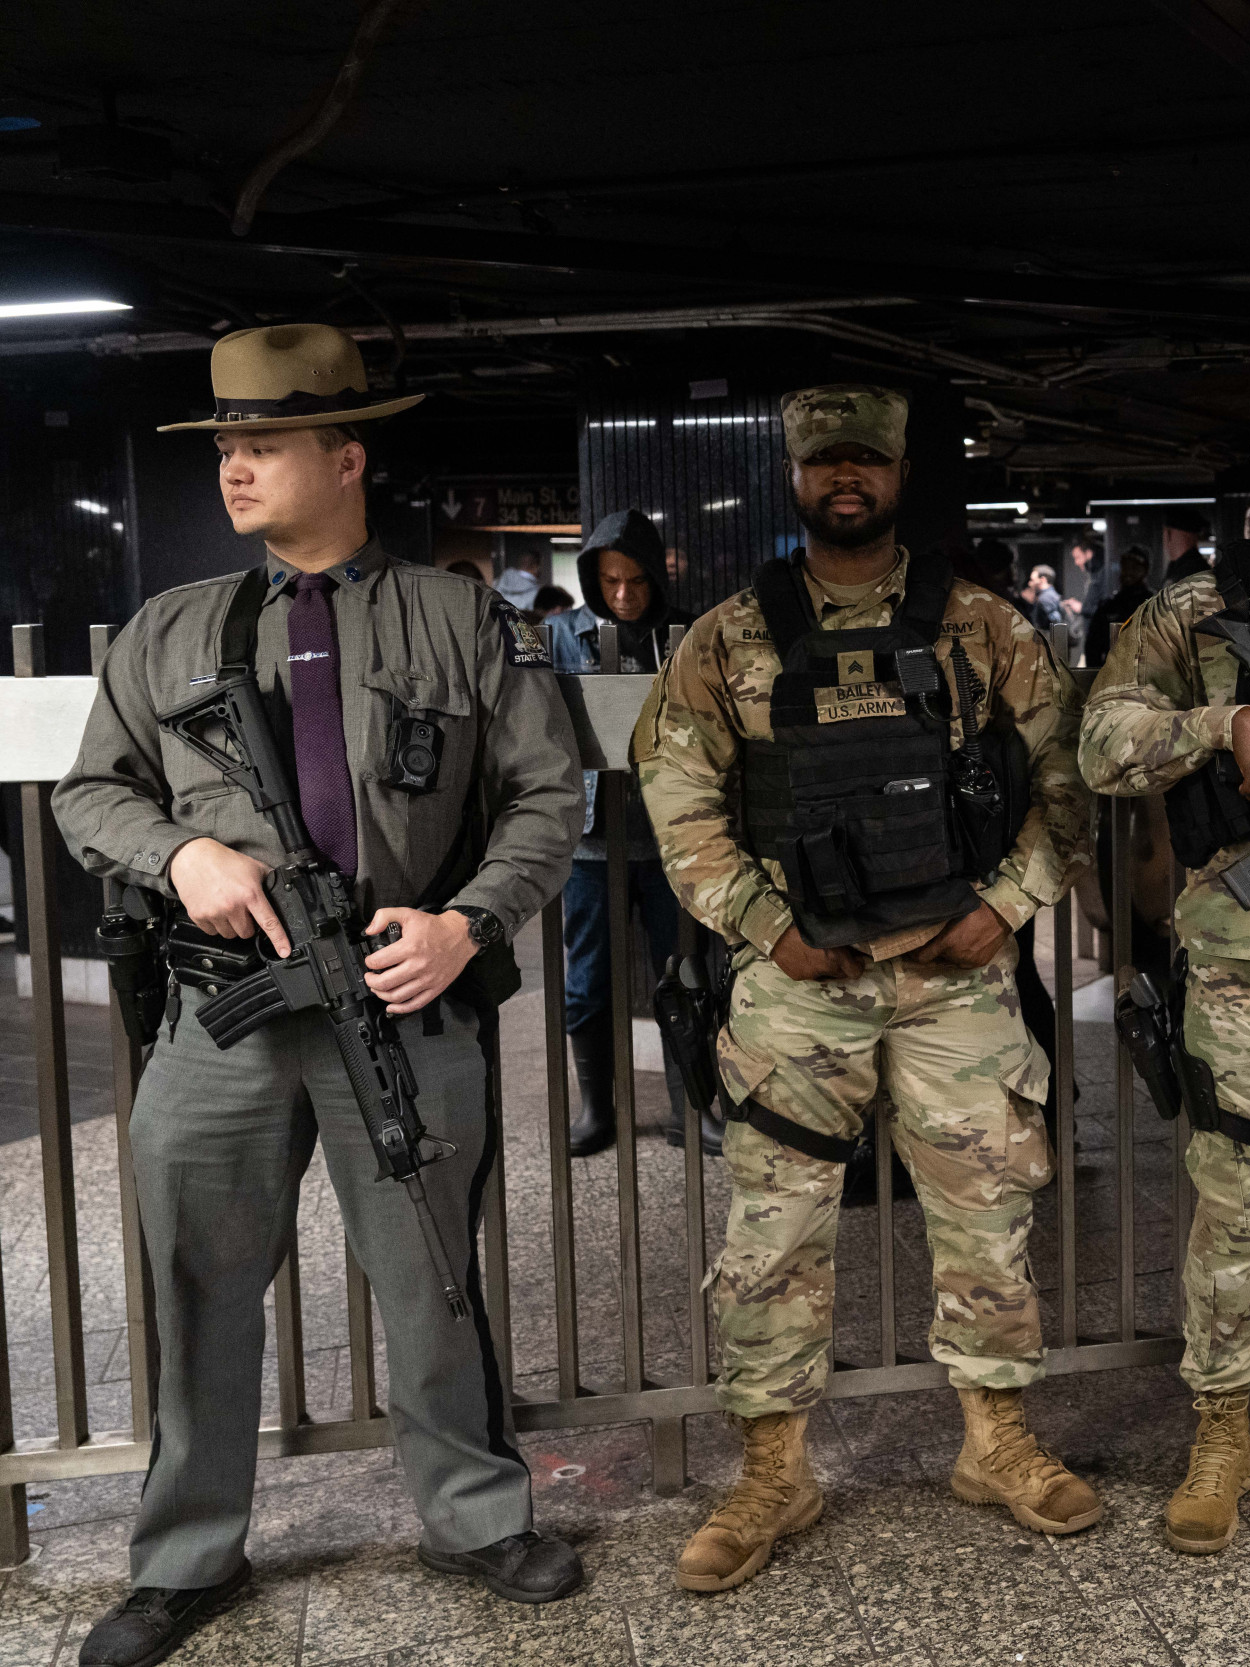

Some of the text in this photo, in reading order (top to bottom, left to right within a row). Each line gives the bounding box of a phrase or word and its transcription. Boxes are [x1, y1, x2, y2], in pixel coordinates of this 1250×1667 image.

[497, 487, 535, 505] Main
[475, 497, 486, 518] 7
[498, 506, 580, 524] 34 St-Hud
[742, 628, 773, 641] BAIL
[514, 654, 537, 663] STATE
[836, 683, 881, 700] BAILEY
[828, 701, 896, 719] U.S. ARMY
